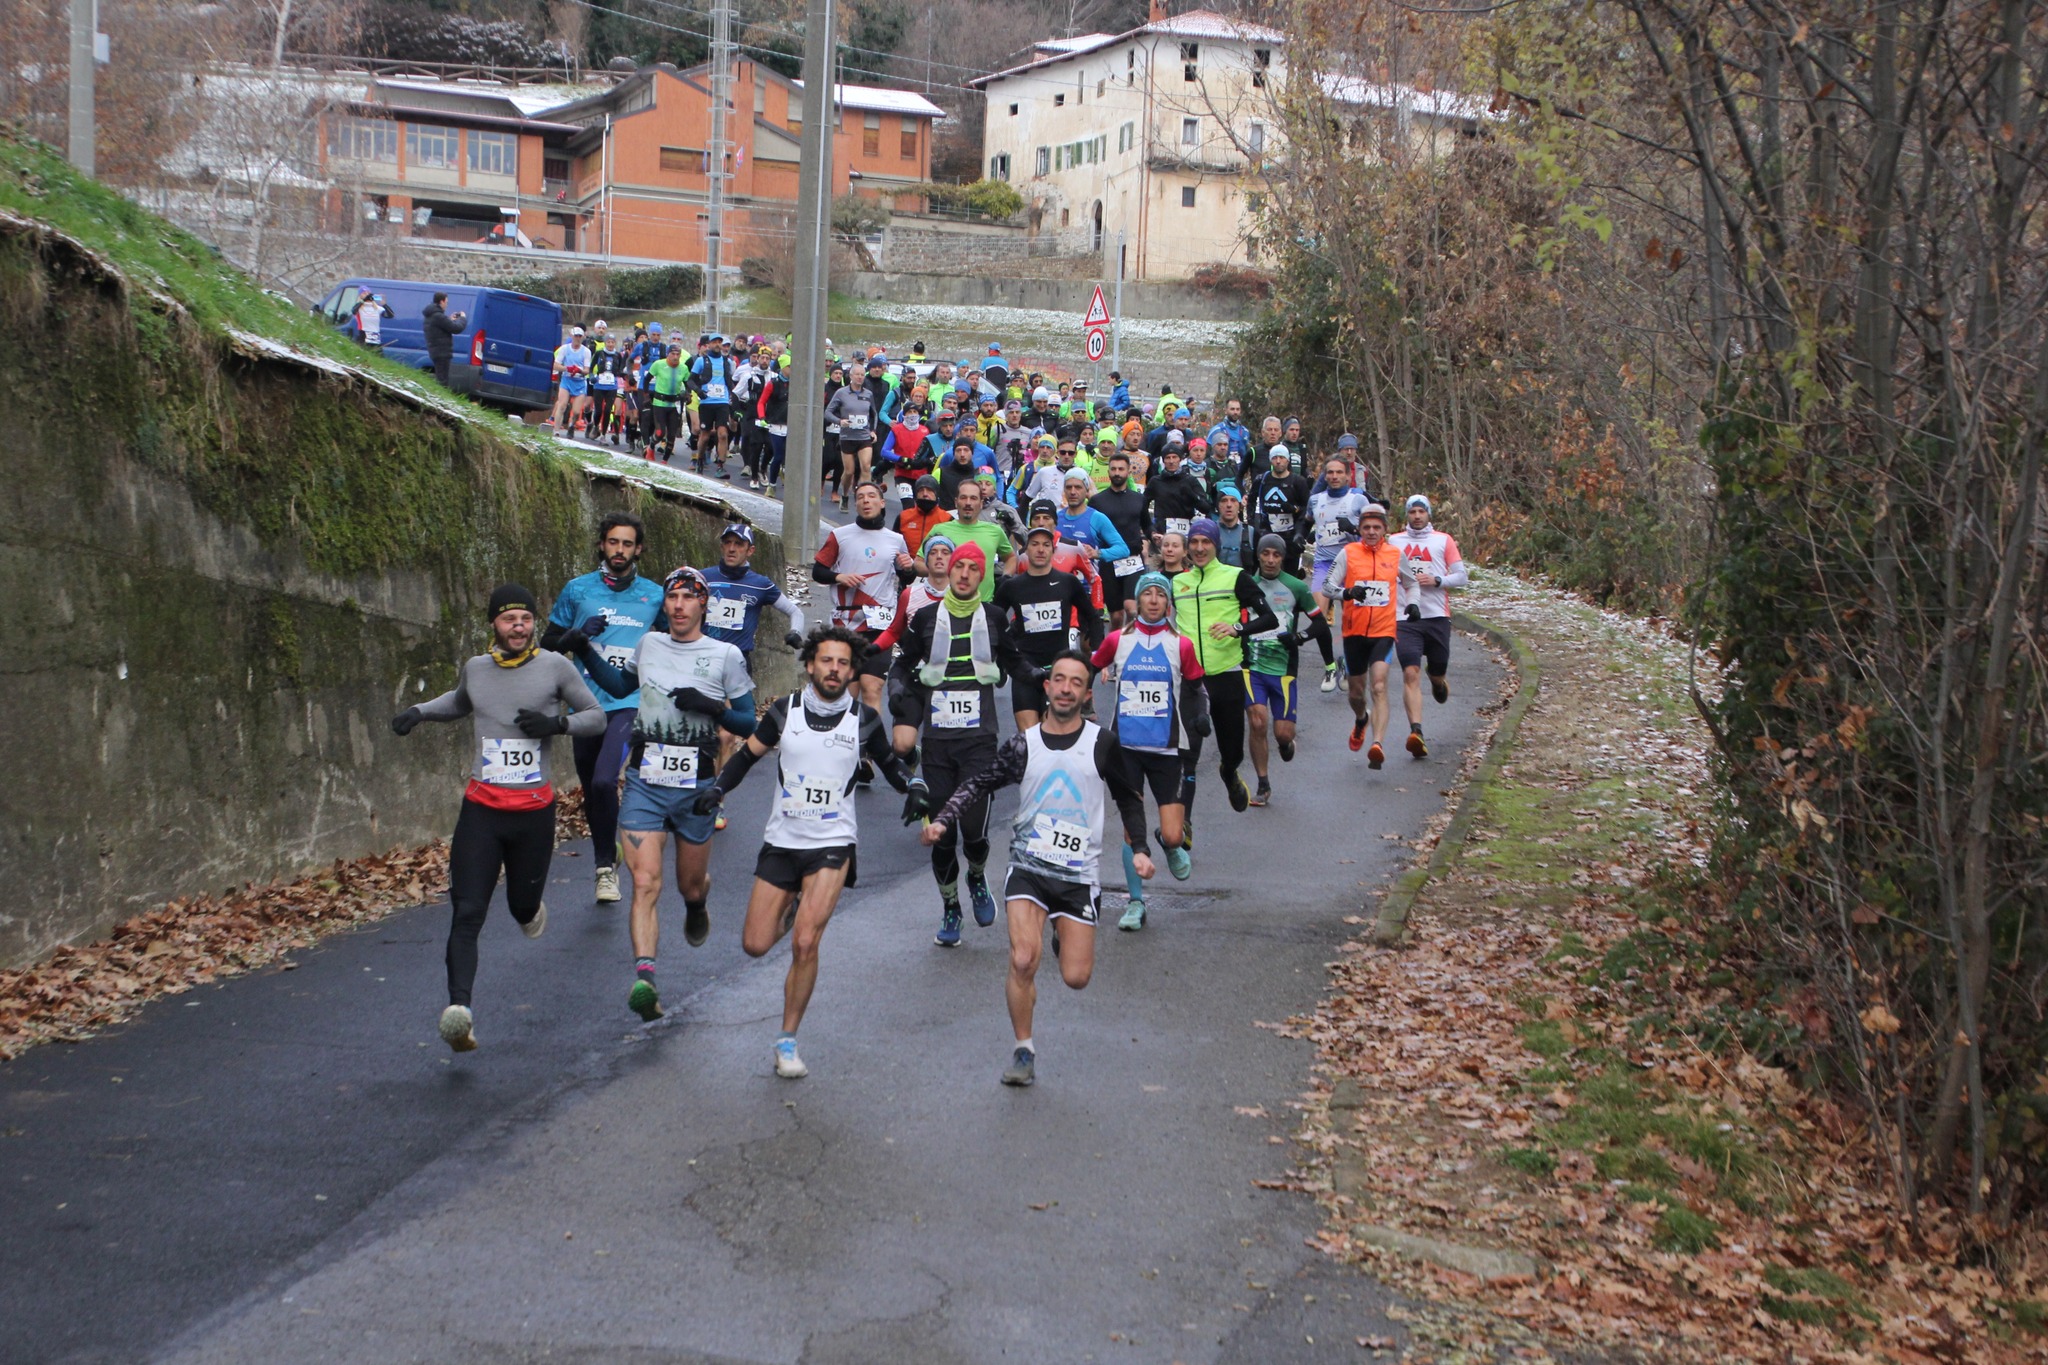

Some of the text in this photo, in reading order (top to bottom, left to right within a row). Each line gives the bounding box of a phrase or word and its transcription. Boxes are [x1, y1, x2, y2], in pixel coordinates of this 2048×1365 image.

[1091, 337, 1101, 353] 10
[1177, 523, 1187, 531] 112
[1279, 518, 1290, 526] 73
[1327, 528, 1342, 537] 141
[1126, 558, 1137, 567] 52
[1369, 587, 1383, 597] 74
[722, 606, 736, 618] 21
[879, 611, 892, 621] 98
[1035, 609, 1057, 621] 102
[607, 655, 626, 669] 63
[1127, 664, 1167, 673] BOGNANCO
[1139, 690, 1161, 703] 116
[949, 700, 972, 714] 115
[501, 750, 533, 766] 130
[662, 755, 691, 772] 136
[490, 770, 528, 783] MEDIUM
[646, 775, 684, 786] MEDIUM
[805, 787, 831, 805] 131
[787, 808, 826, 818] MEDIUM
[1052, 830, 1081, 852] 138
[1034, 851, 1073, 860] MEDIUM
